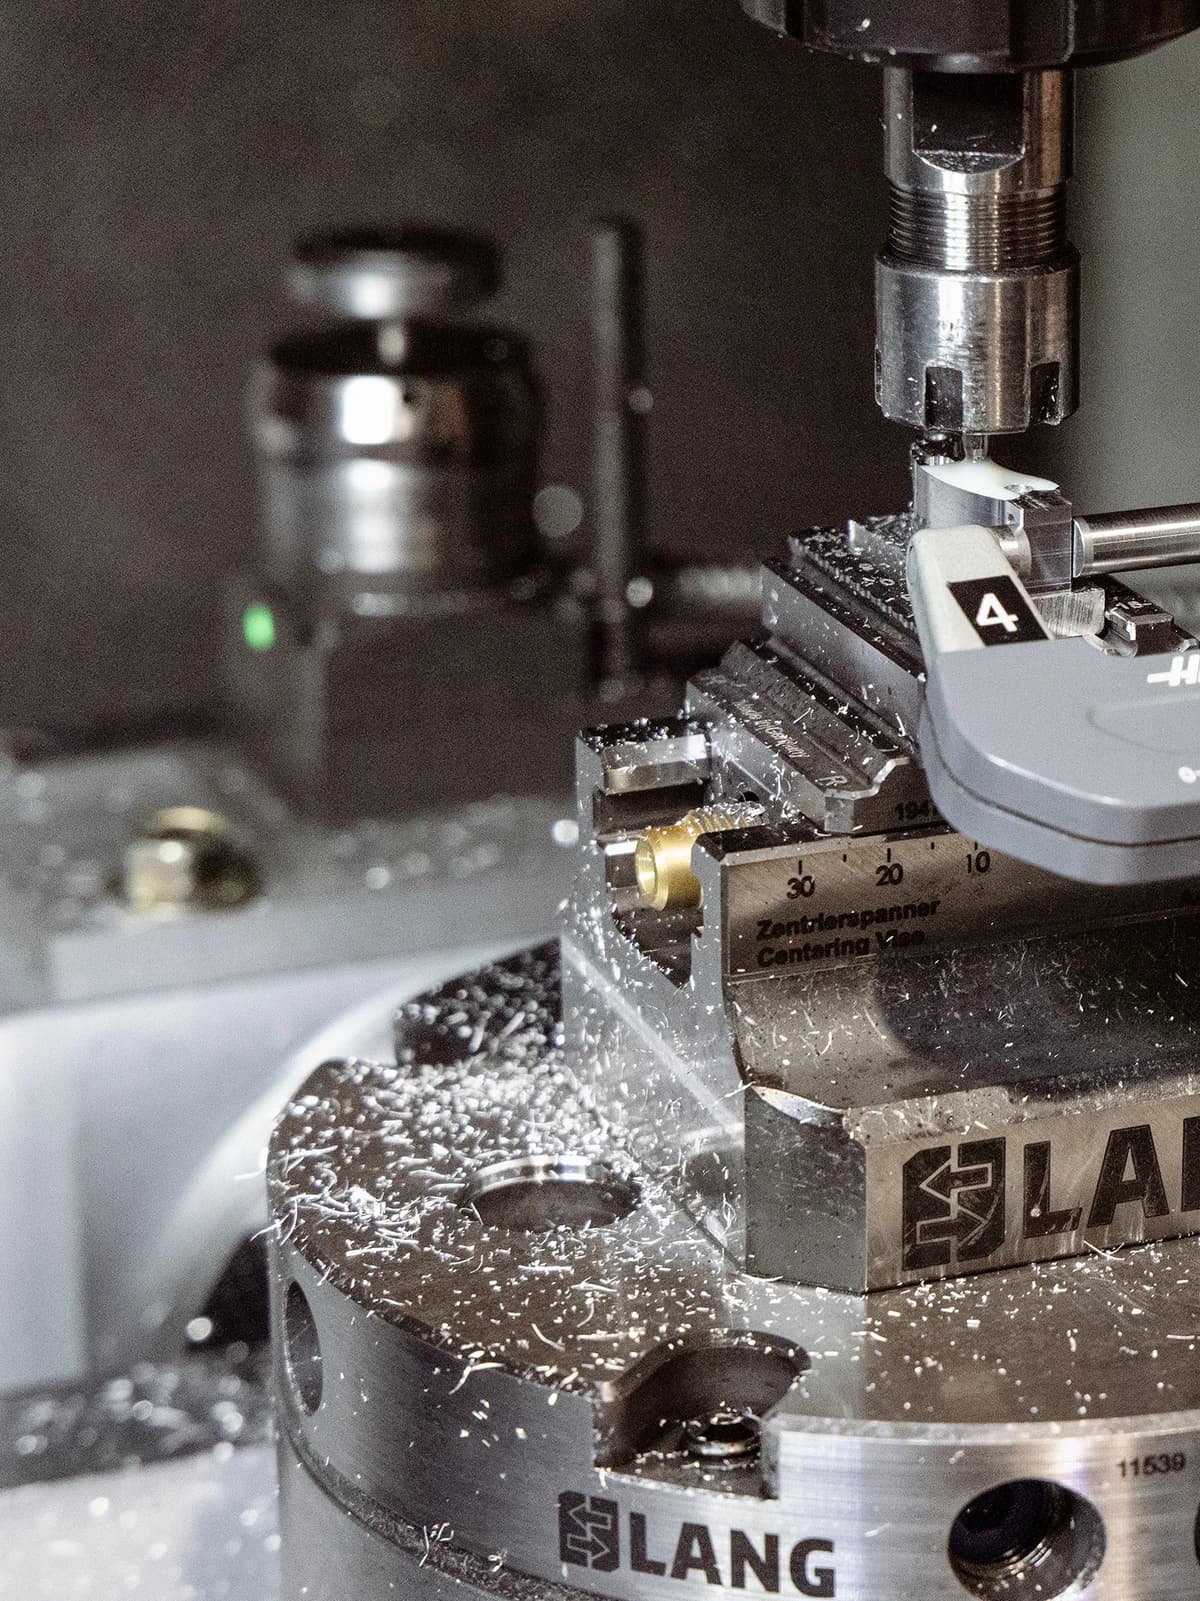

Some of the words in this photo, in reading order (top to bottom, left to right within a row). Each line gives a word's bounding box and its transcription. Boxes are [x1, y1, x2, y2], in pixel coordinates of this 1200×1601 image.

[975, 592, 1018, 632] 4
[786, 875, 815, 899] 30
[876, 863, 903, 886] 20
[966, 851, 990, 873] 10
[757, 900, 941, 941] Zentrierspanner
[757, 936, 870, 967] Centering
[876, 929, 926, 950] Vise
[629, 1511, 837, 1599] LANG
